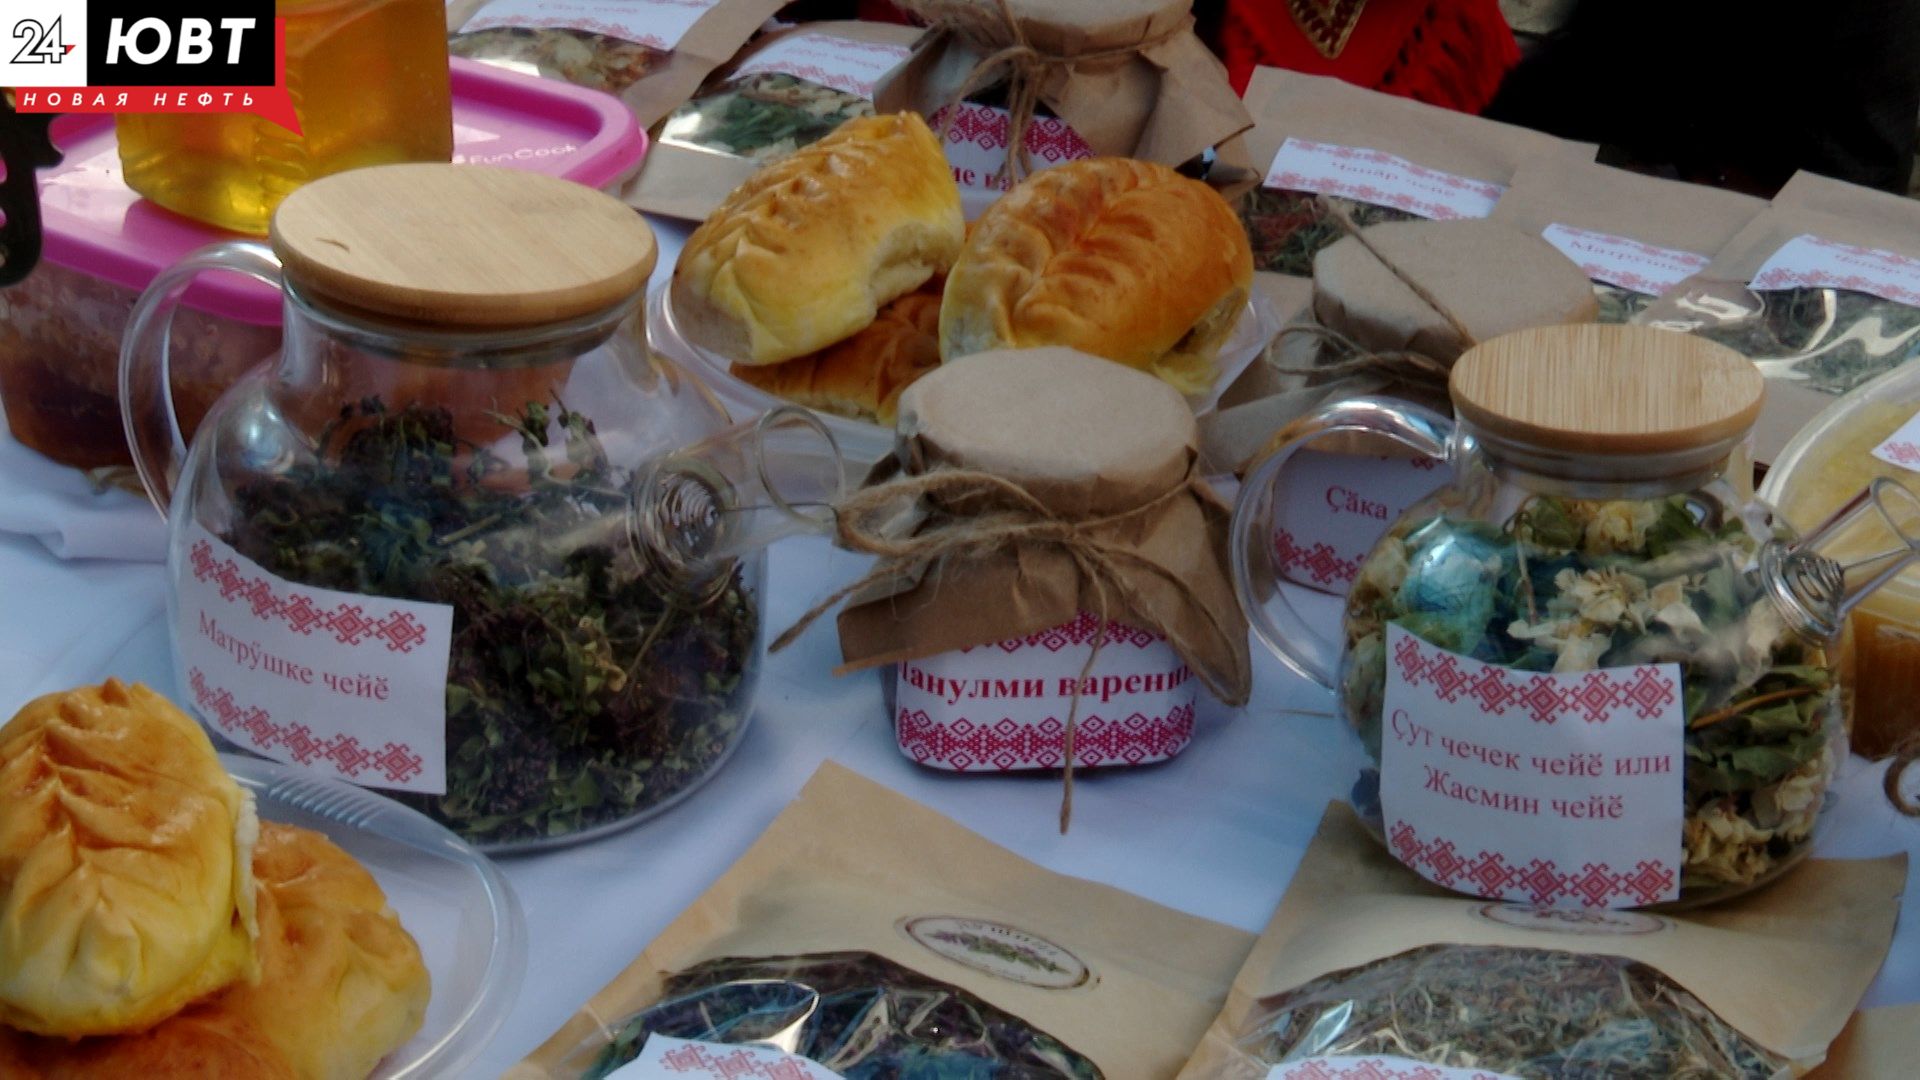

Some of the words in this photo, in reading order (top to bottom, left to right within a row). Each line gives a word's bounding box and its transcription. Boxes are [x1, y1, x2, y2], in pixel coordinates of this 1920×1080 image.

[1058, 664, 1193, 703] варени
[1440, 736, 1521, 771] чечек
[1614, 754, 1672, 776] или
[1422, 763, 1540, 815] Жасмин
